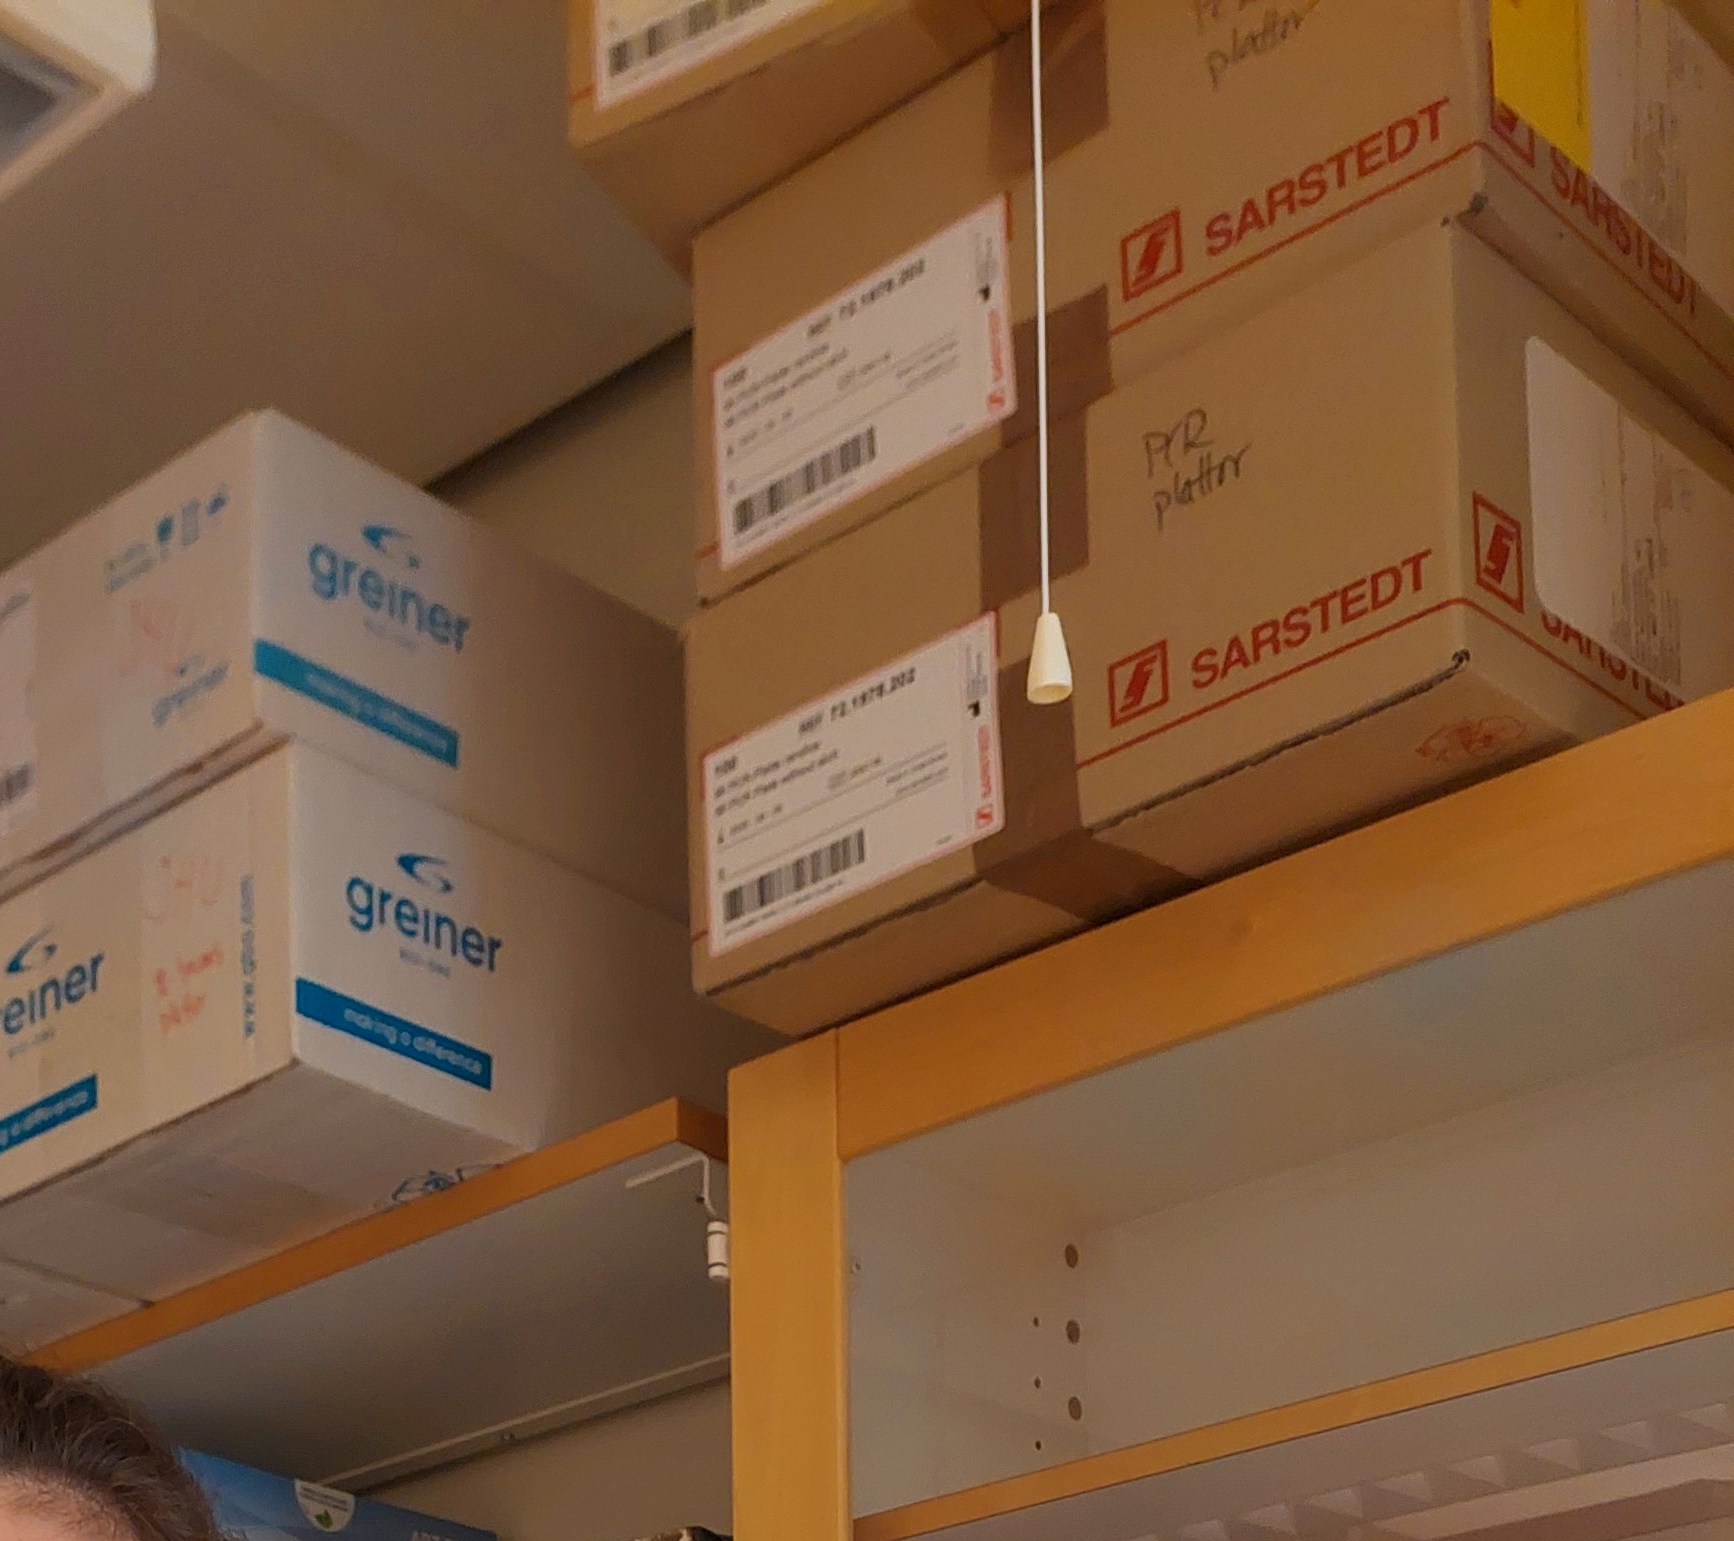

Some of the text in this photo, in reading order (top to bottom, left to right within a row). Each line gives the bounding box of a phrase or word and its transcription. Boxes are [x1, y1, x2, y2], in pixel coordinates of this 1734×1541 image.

[1205, 97, 1450, 259] SARSTEDT
[308, 542, 470, 653] greiner
[1192, 548, 1432, 690] SARSTEDT
[345, 875, 503, 973] greiner
